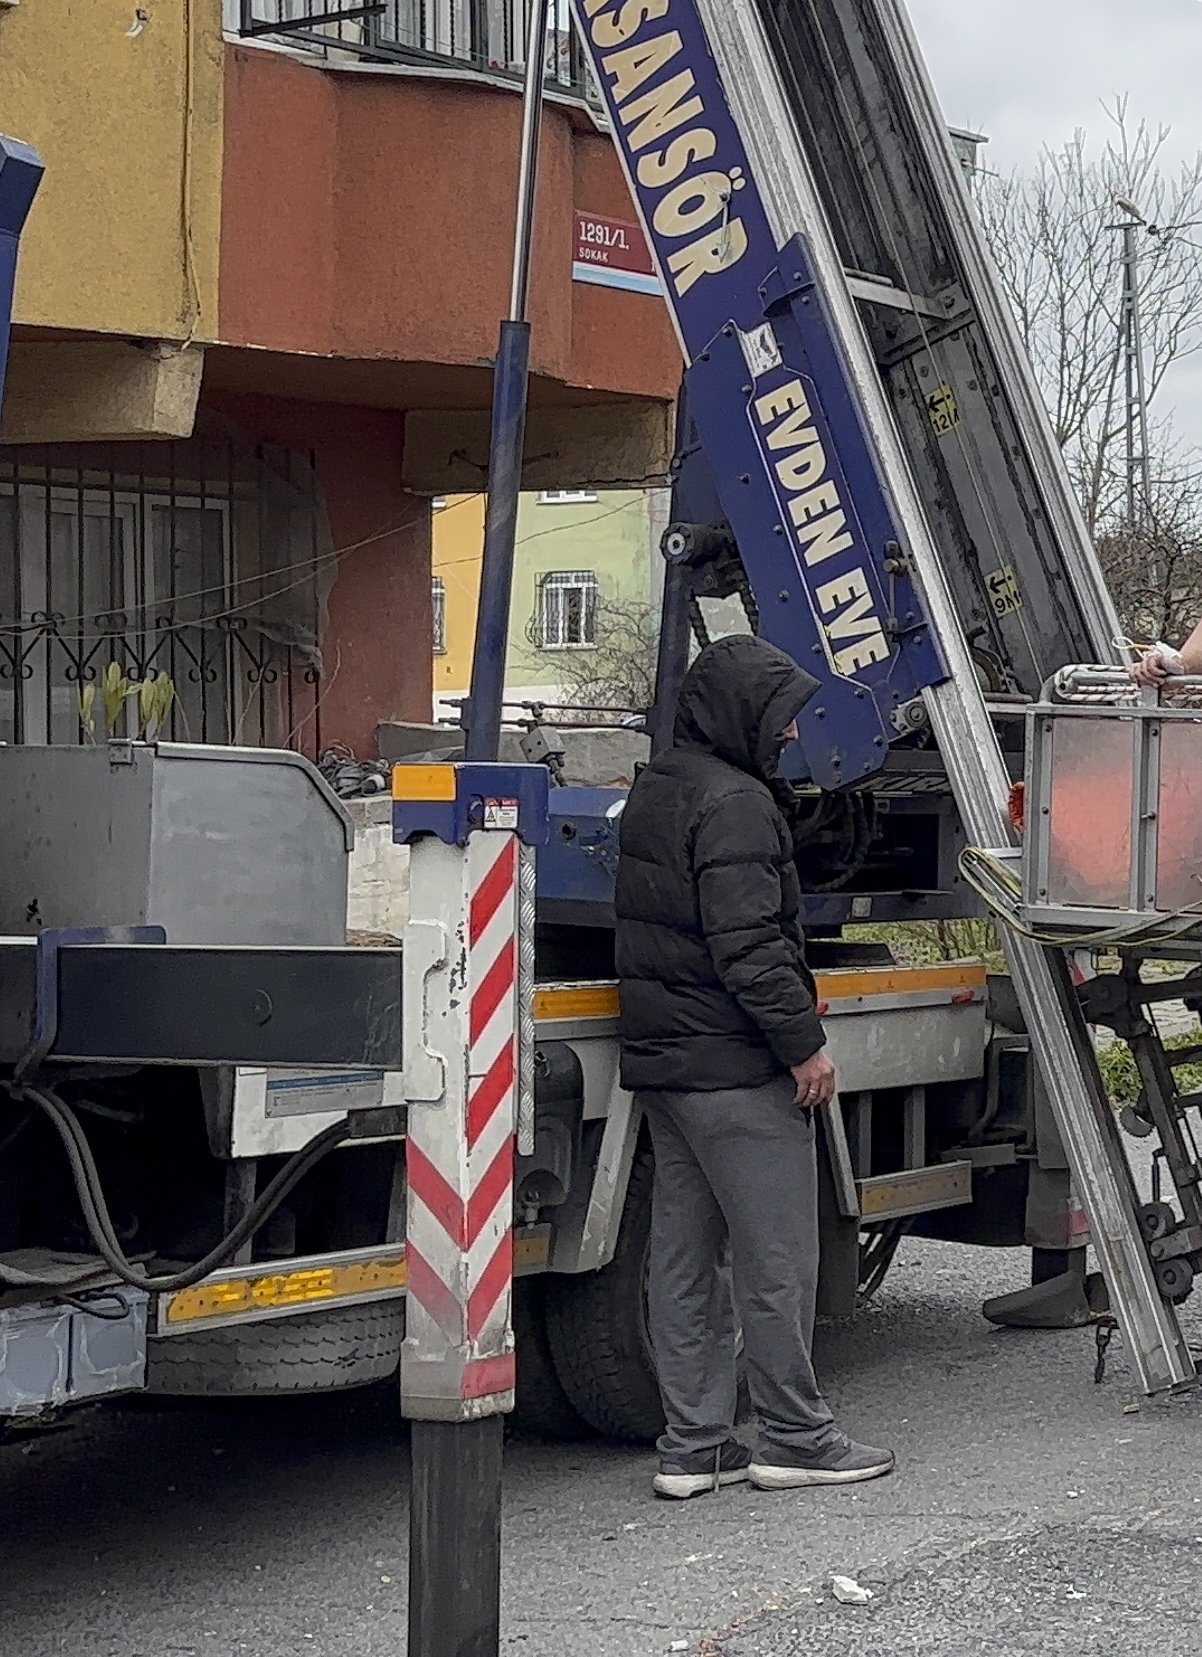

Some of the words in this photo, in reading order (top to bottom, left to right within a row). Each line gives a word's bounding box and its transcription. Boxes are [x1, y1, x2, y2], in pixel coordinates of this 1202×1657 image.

[579, 247, 609, 262] SOKAK
[583, 0, 749, 298] SANSÖR
[754, 379, 856, 568] EVDEN
[815, 566, 890, 677] EVE
